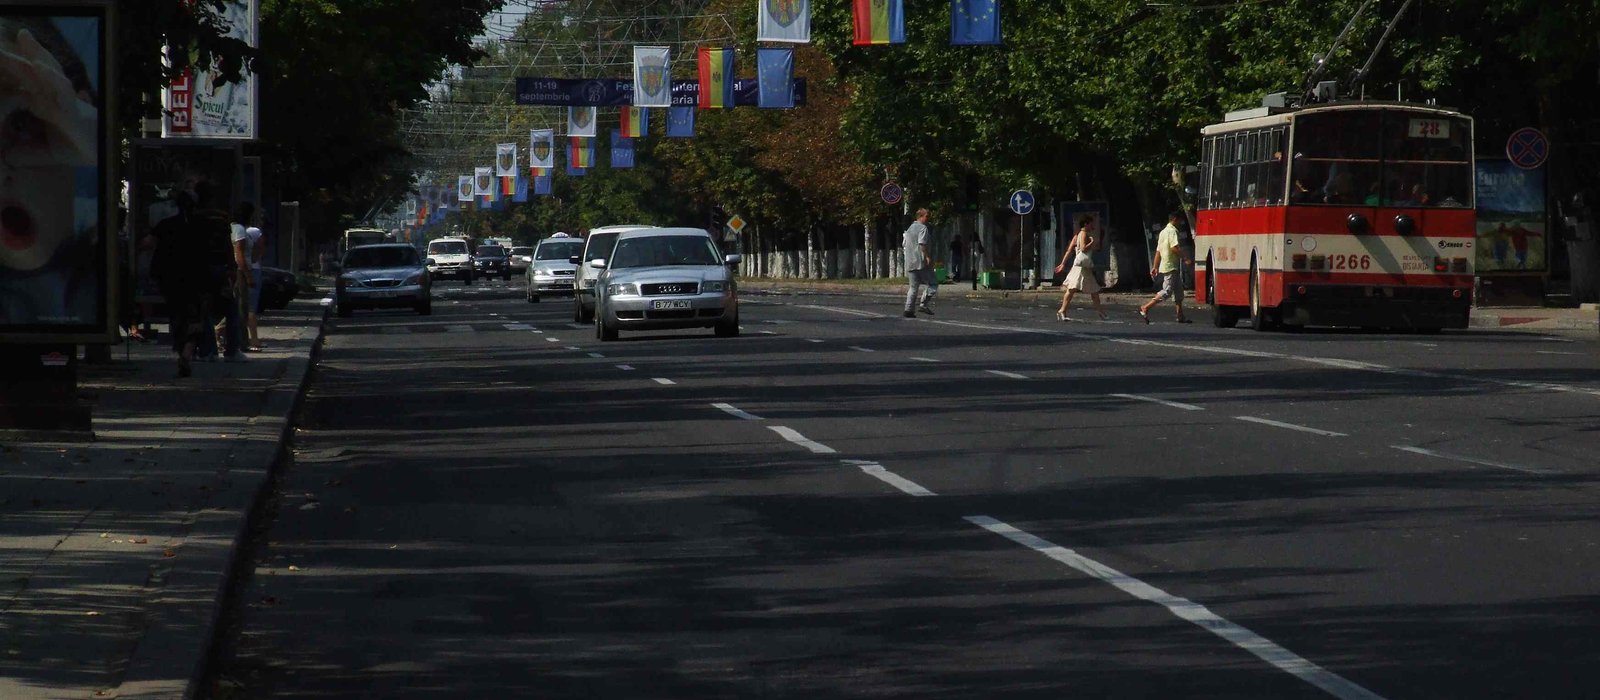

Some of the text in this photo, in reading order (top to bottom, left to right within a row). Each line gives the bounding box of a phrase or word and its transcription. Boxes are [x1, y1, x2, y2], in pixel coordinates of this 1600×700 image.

[534, 81, 557, 90] 11-19
[519, 92, 570, 101] septembrie
[671, 94, 693, 104] aria
[1419, 121, 1440, 135] 28
[1327, 254, 1371, 269] 1266
